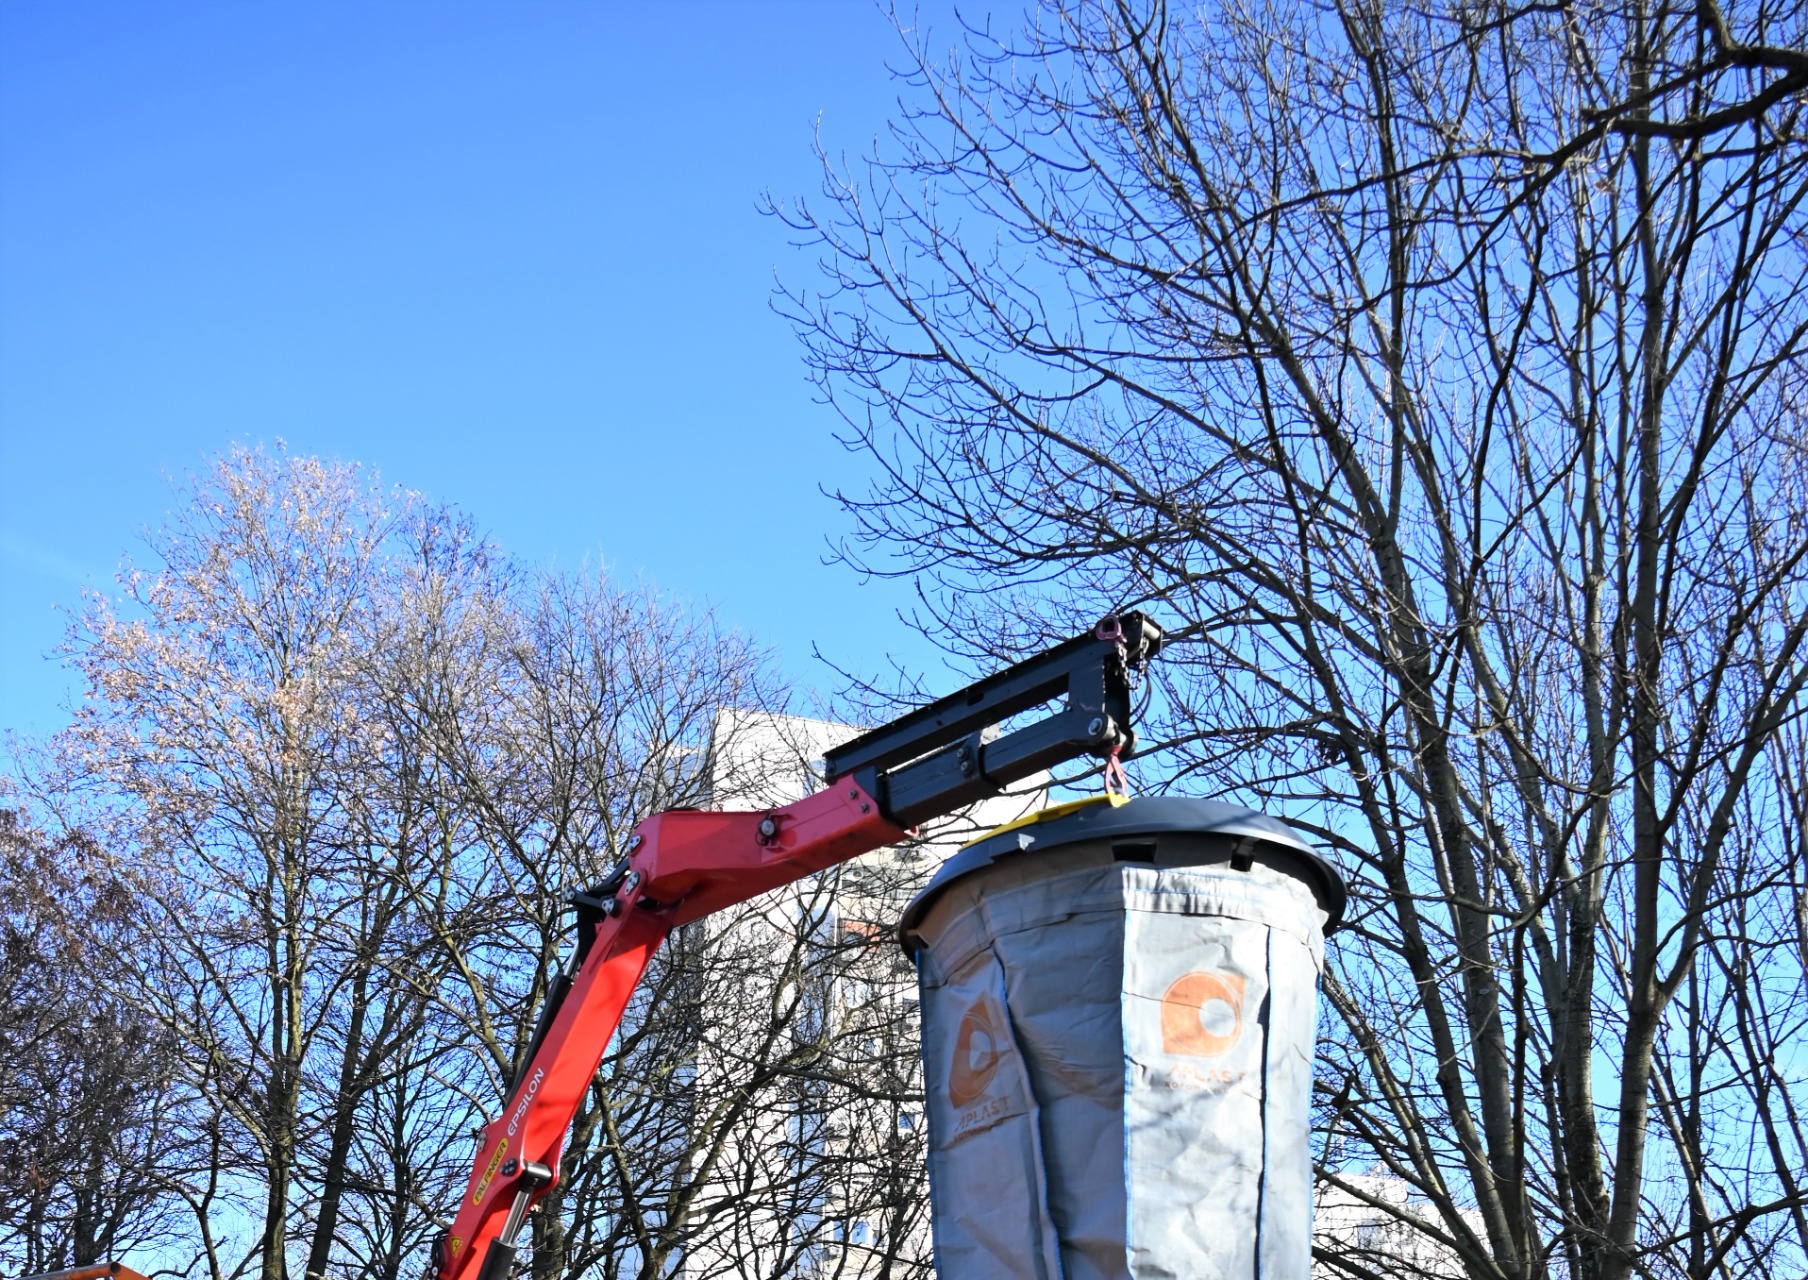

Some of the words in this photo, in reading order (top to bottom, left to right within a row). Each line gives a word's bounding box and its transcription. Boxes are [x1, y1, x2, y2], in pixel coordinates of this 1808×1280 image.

[507, 1068, 544, 1136] EPSILON
[954, 1096, 1009, 1132] APLAST
[474, 1142, 507, 1202] PALFINGER
